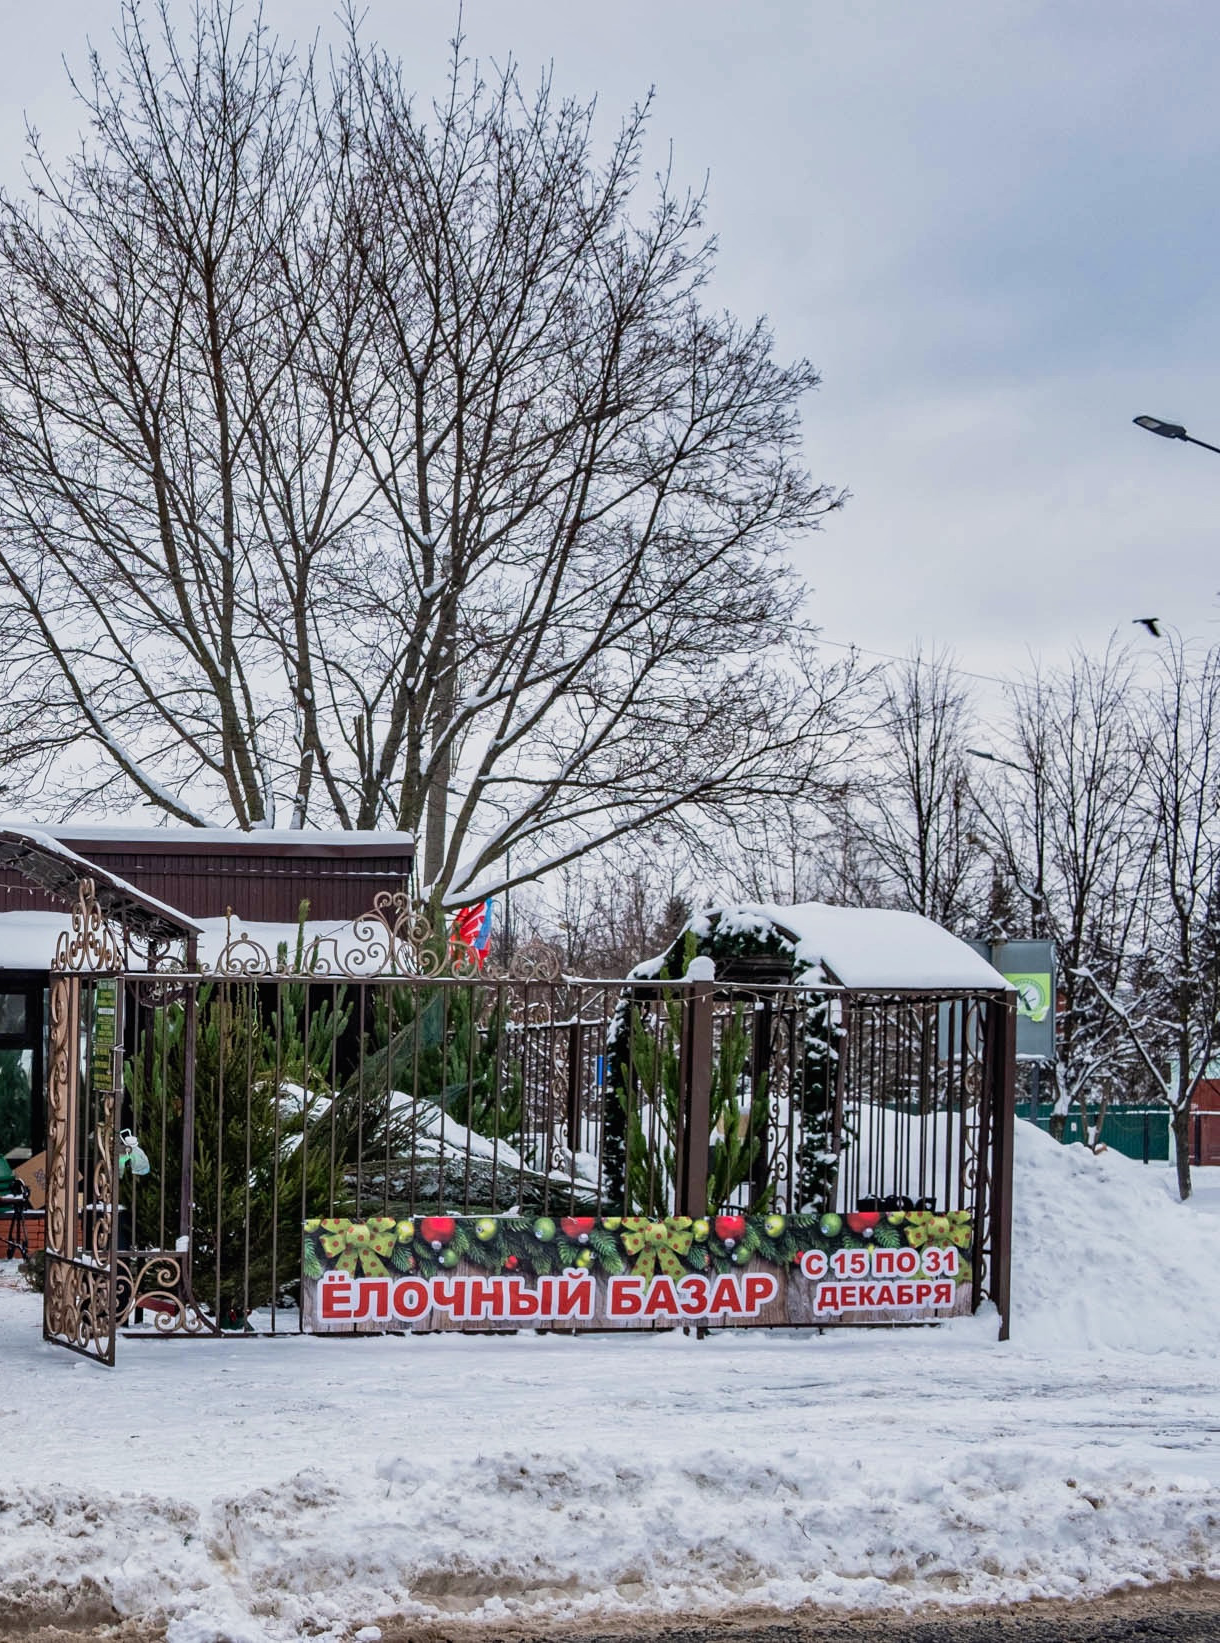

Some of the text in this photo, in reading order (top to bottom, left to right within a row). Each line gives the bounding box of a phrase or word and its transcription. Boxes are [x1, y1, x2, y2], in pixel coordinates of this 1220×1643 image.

[805, 1251, 955, 1275] С 15 ПО 31
[321, 1272, 776, 1319] ЁЛОЧНЫЙ БАЗАР
[817, 1284, 952, 1312] ДЕКАБРЯ
